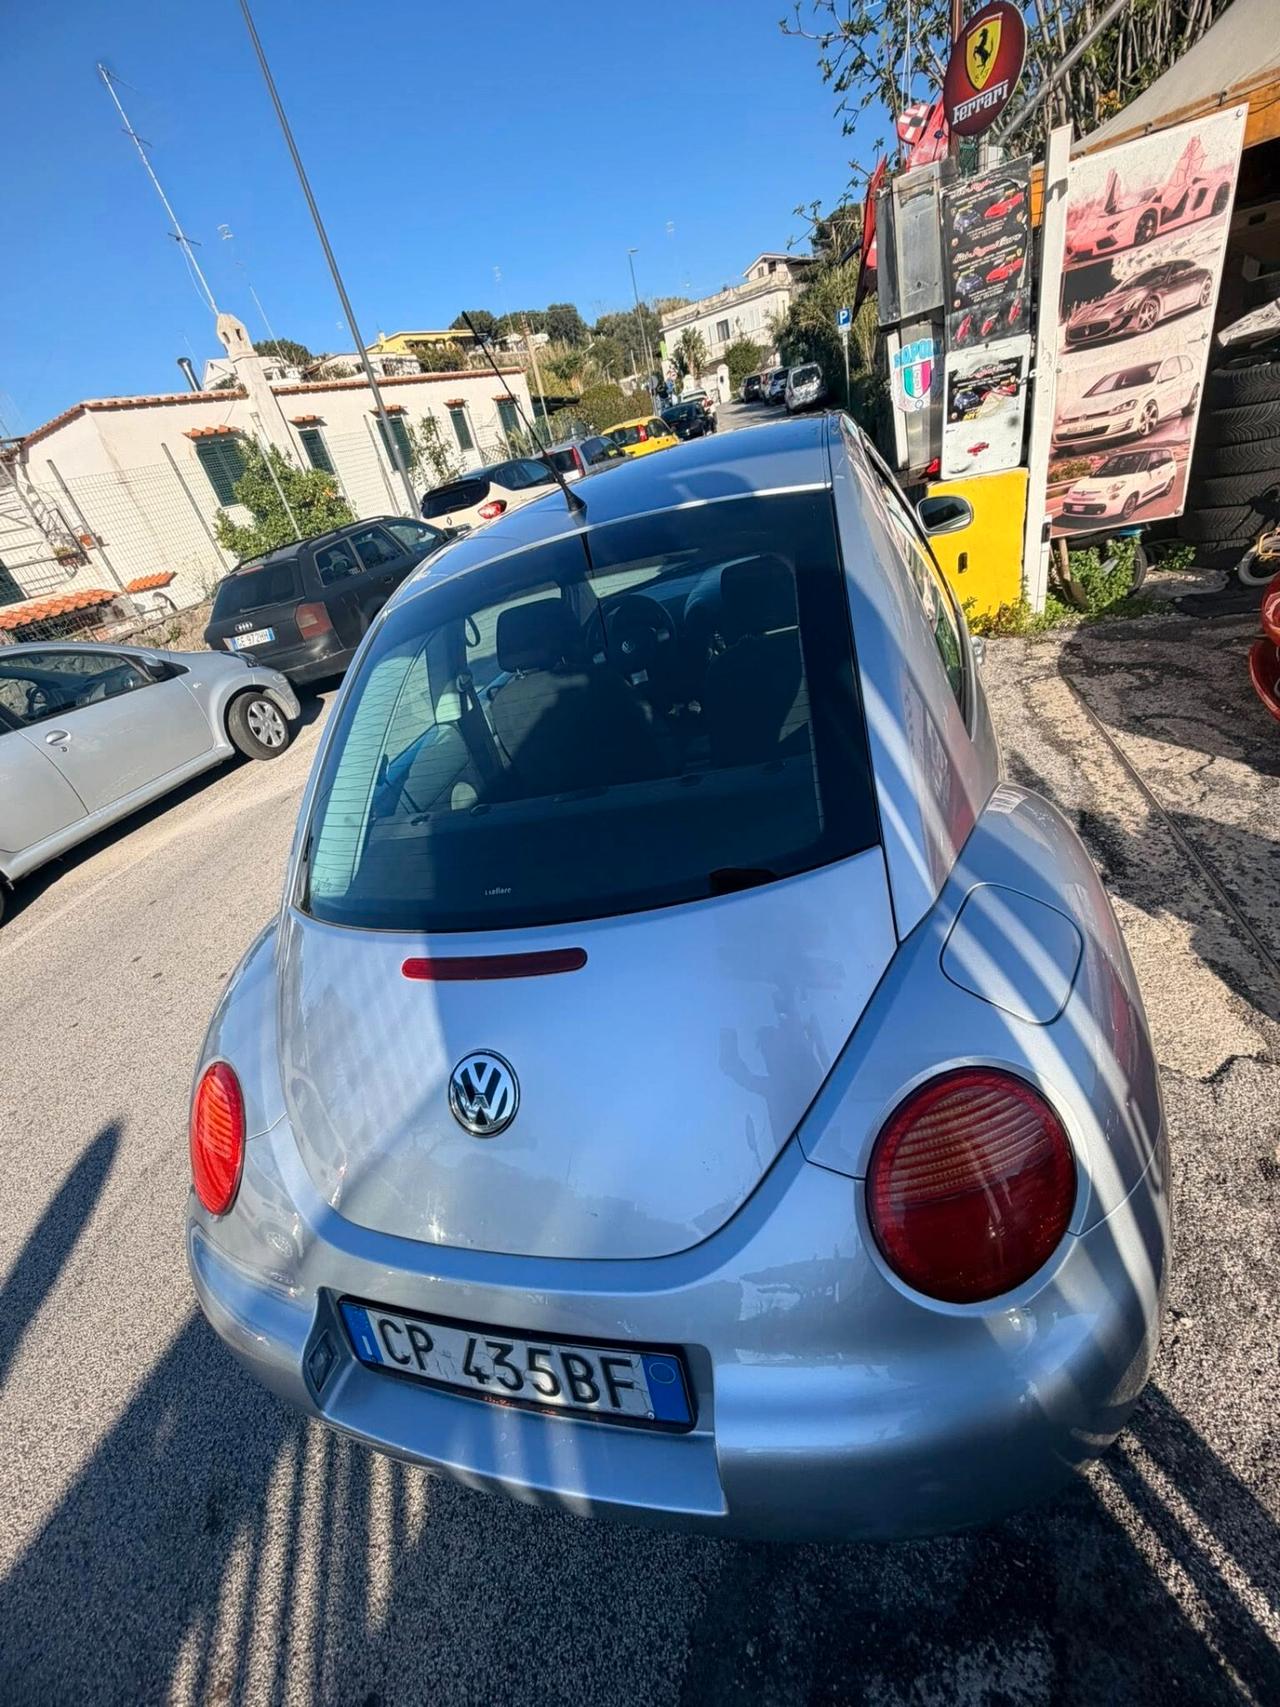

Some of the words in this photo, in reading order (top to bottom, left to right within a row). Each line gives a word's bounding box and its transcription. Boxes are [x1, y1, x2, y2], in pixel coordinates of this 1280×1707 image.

[952, 80, 1008, 126] Ferrari
[839, 310, 848, 324] P
[377, 1318, 434, 1371] CP
[462, 1337, 636, 1409] 435BF
